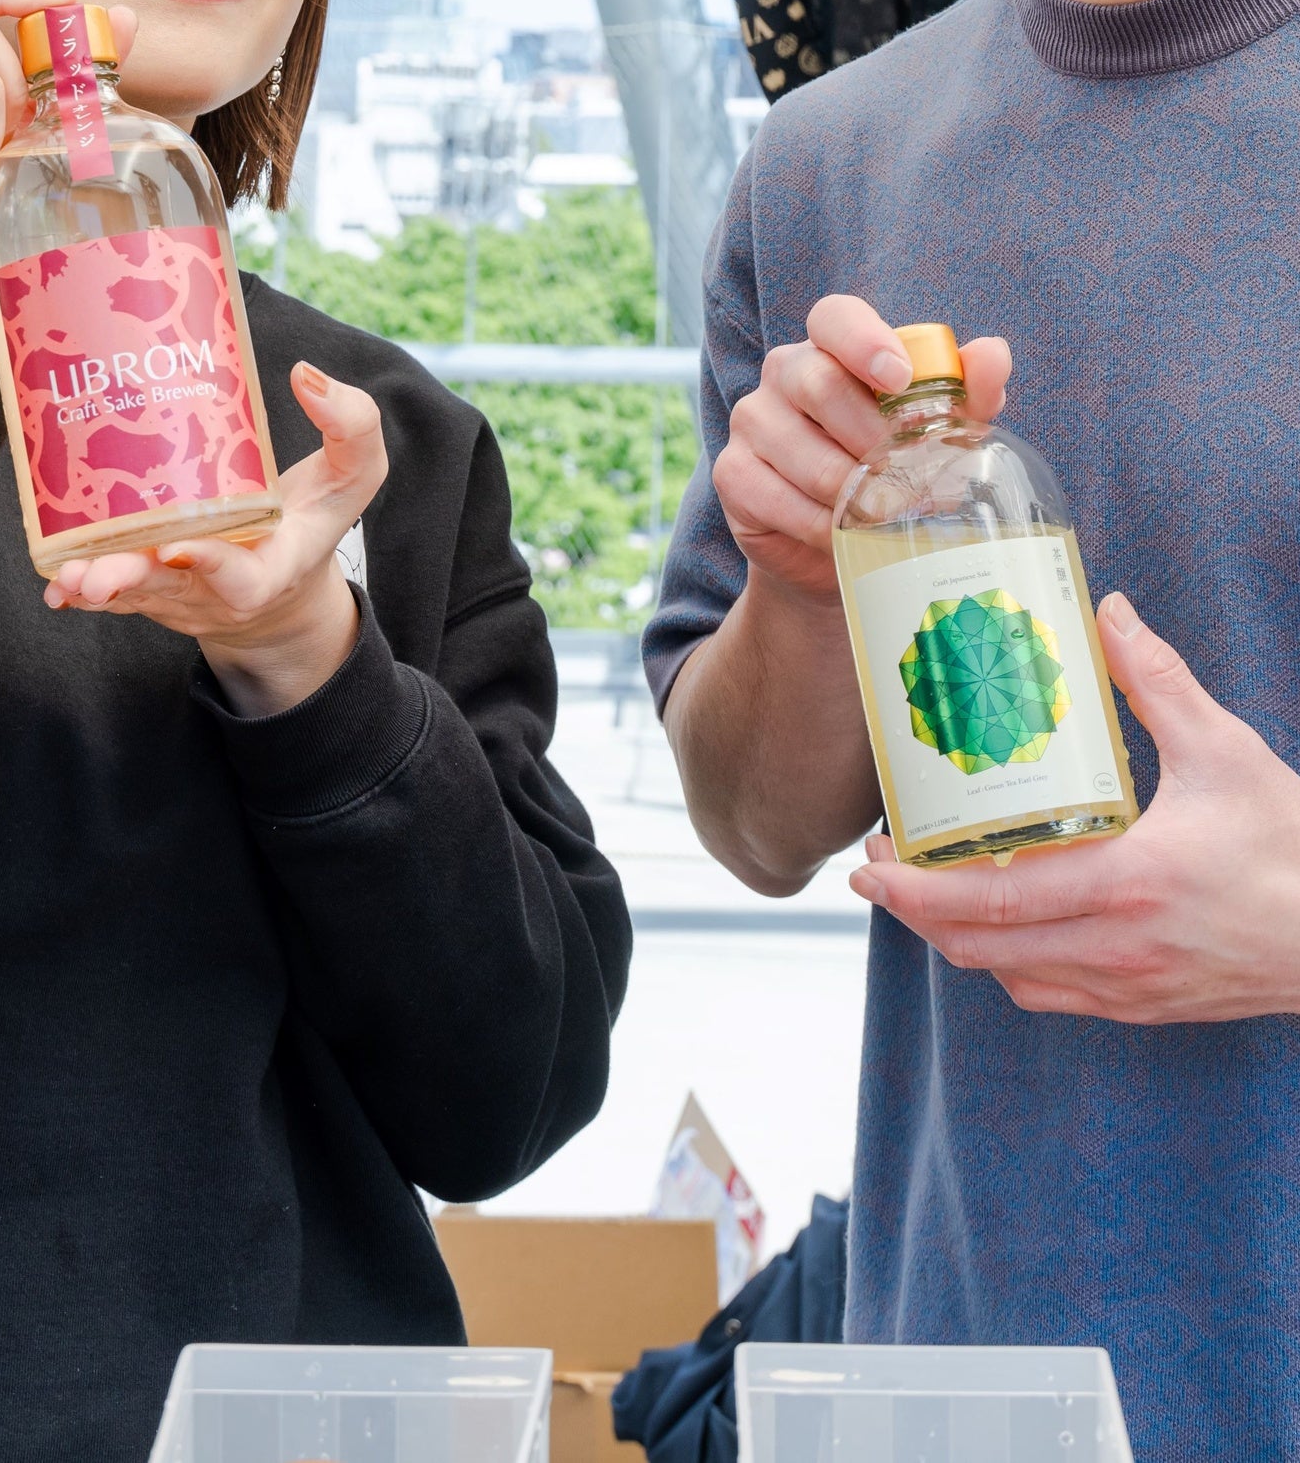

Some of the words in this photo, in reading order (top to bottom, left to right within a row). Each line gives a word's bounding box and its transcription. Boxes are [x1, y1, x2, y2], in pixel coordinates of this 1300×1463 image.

[48, 339, 216, 405] LIBROM
[57, 399, 100, 425] Craft
[103, 392, 147, 415] Sake
[151, 382, 219, 404] Brewery
[949, 574, 976, 586] Japanese
